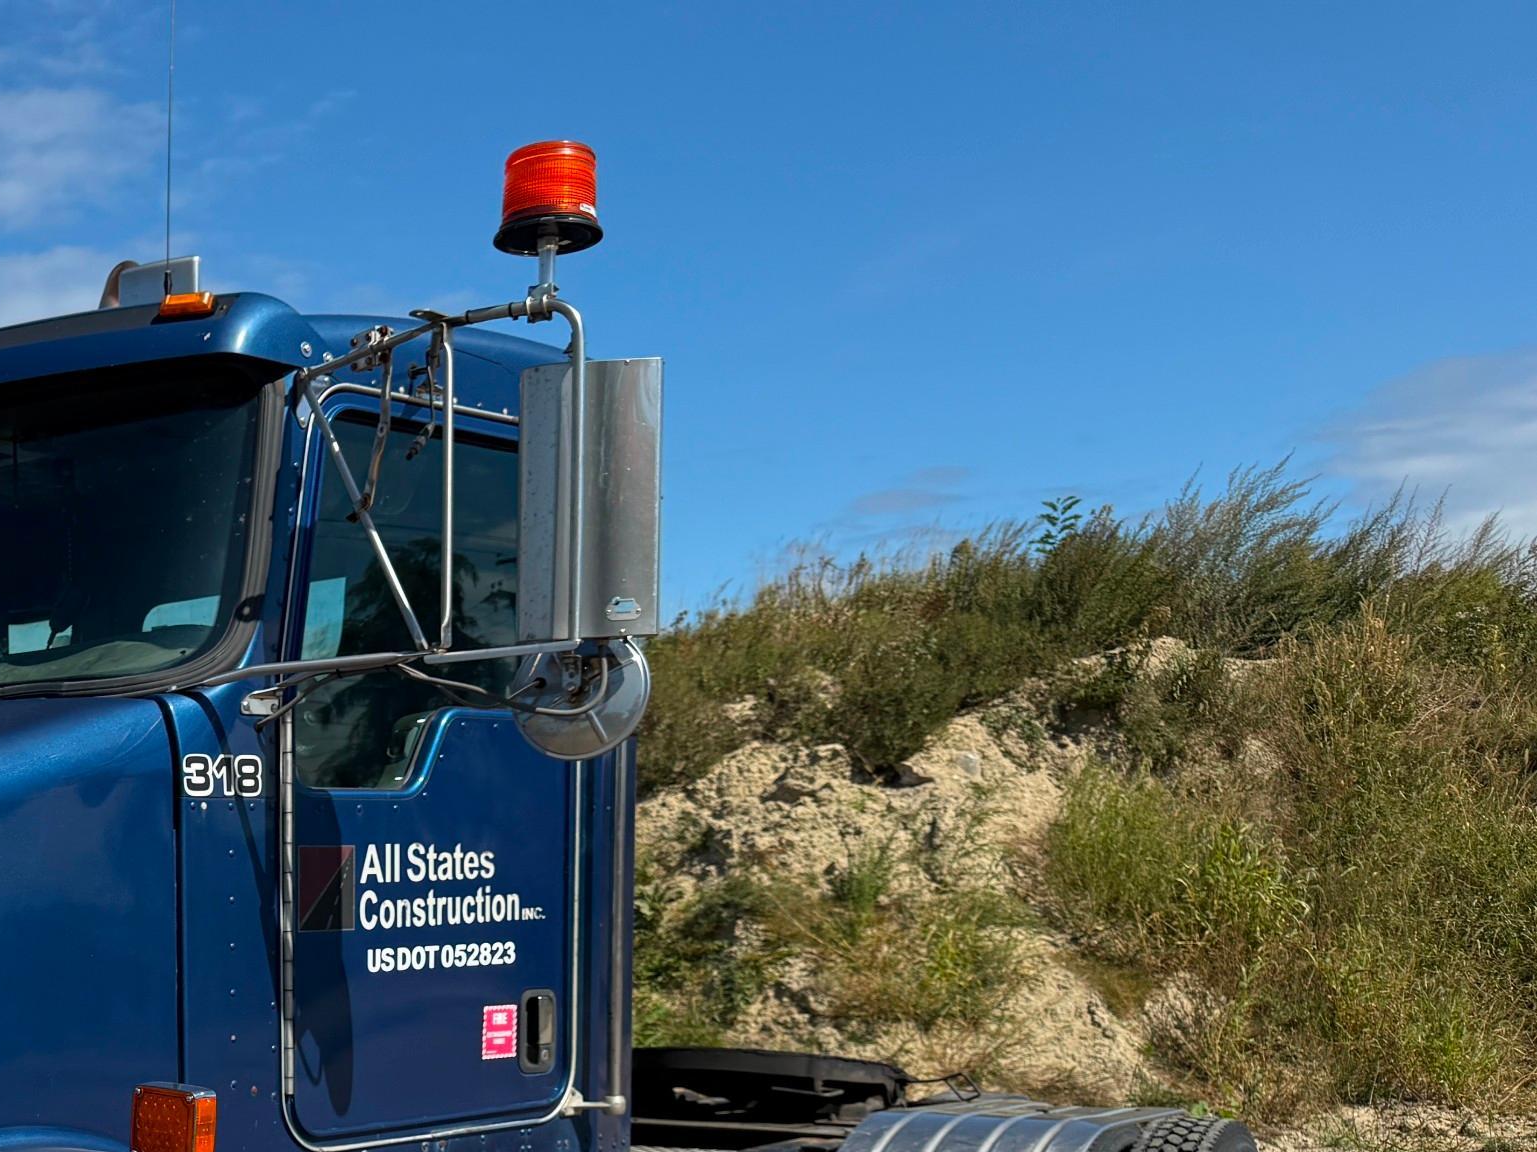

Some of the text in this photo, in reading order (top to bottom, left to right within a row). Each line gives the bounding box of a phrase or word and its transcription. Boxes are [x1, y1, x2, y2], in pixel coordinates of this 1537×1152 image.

[183, 753, 263, 797] 318
[359, 842, 496, 884] All States
[359, 885, 521, 931] Construction
[440, 941, 516, 968] 052823
